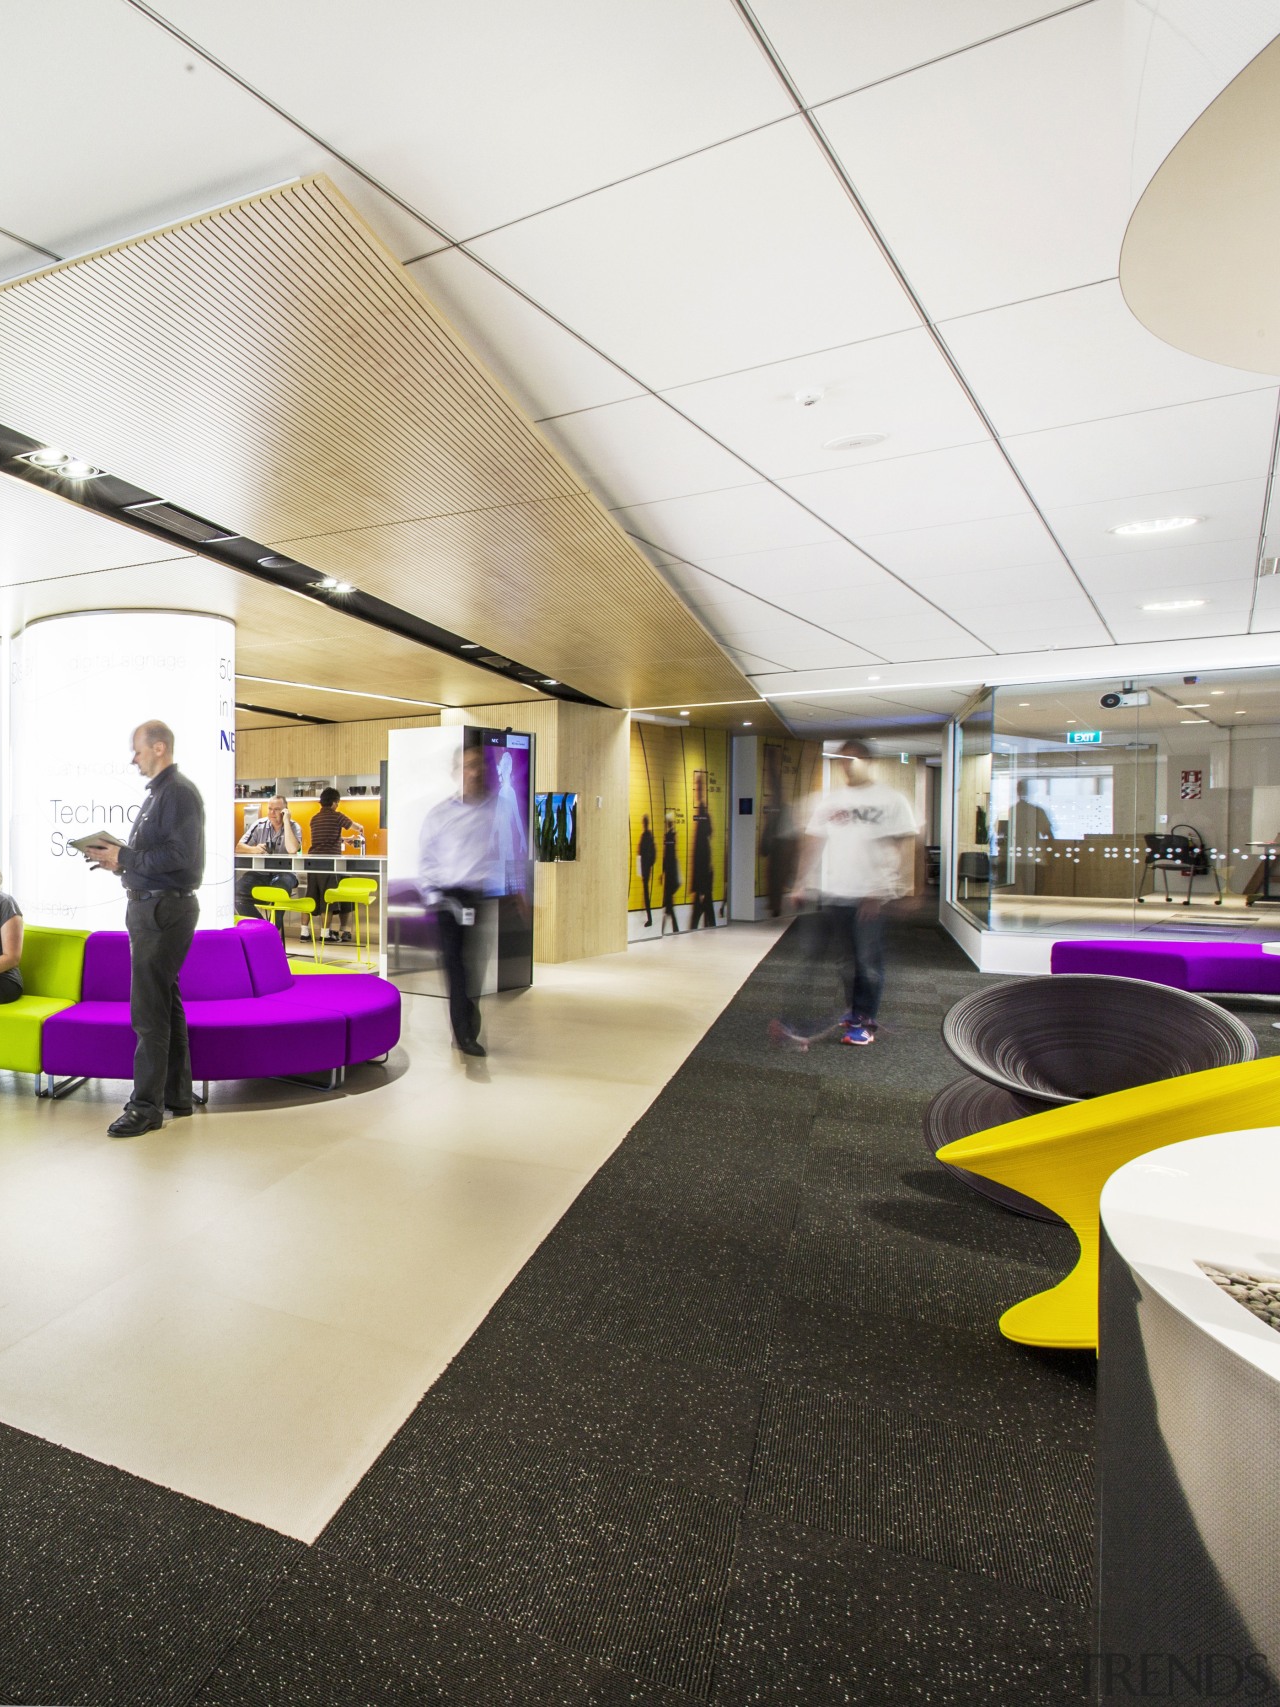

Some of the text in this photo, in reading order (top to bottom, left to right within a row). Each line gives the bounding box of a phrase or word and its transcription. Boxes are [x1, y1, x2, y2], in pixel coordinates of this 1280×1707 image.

[120, 653, 187, 672] signage
[1074, 733, 1095, 742] EXIT
[50, 800, 142, 824] Techno
